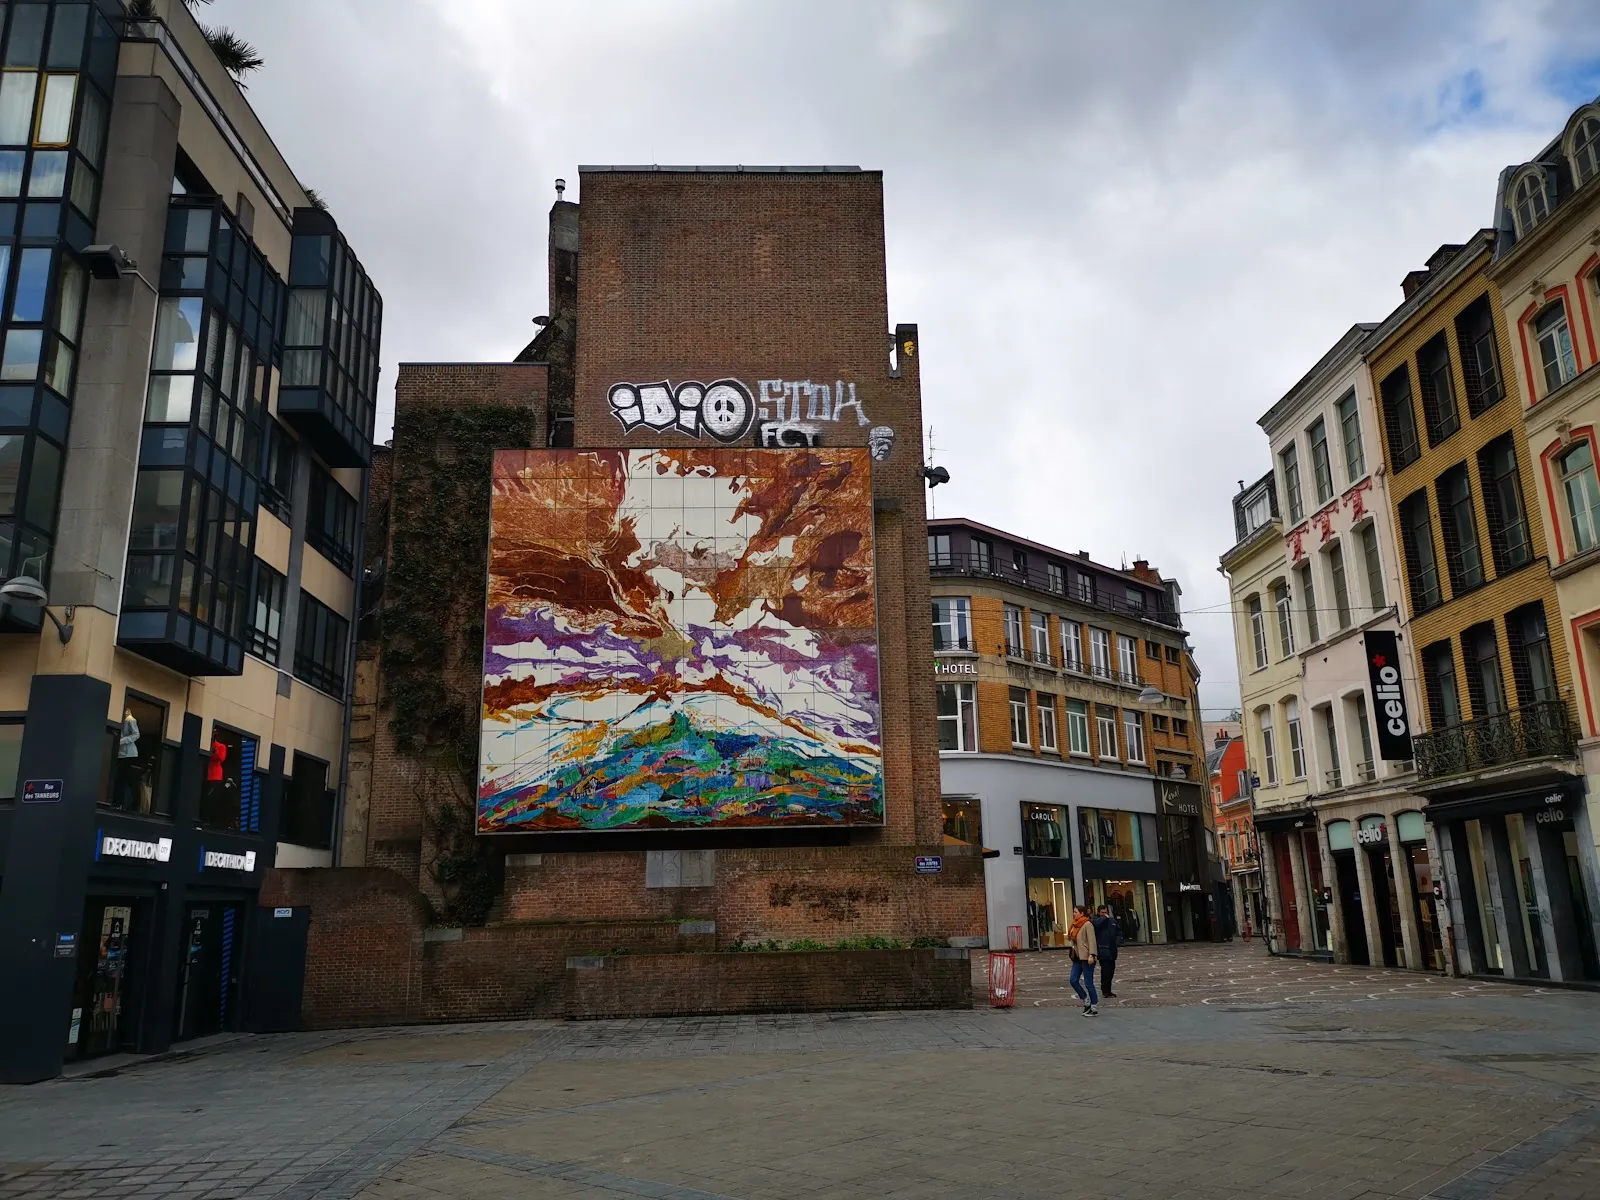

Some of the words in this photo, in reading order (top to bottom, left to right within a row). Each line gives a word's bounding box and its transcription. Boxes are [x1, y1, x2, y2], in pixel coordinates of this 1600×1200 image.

[942, 663, 978, 674] HOTEL
[1376, 666, 1406, 736] celio
[34, 791, 60, 799] TANNEURS
[1545, 793, 1562, 804] celio
[1178, 803, 1199, 814] HOTEL
[1536, 807, 1565, 824] celio
[1031, 812, 1054, 822] CAROLL
[1357, 824, 1382, 844] celio
[102, 836, 160, 861] DECATHLON
[204, 851, 246, 871] DECATHLON
